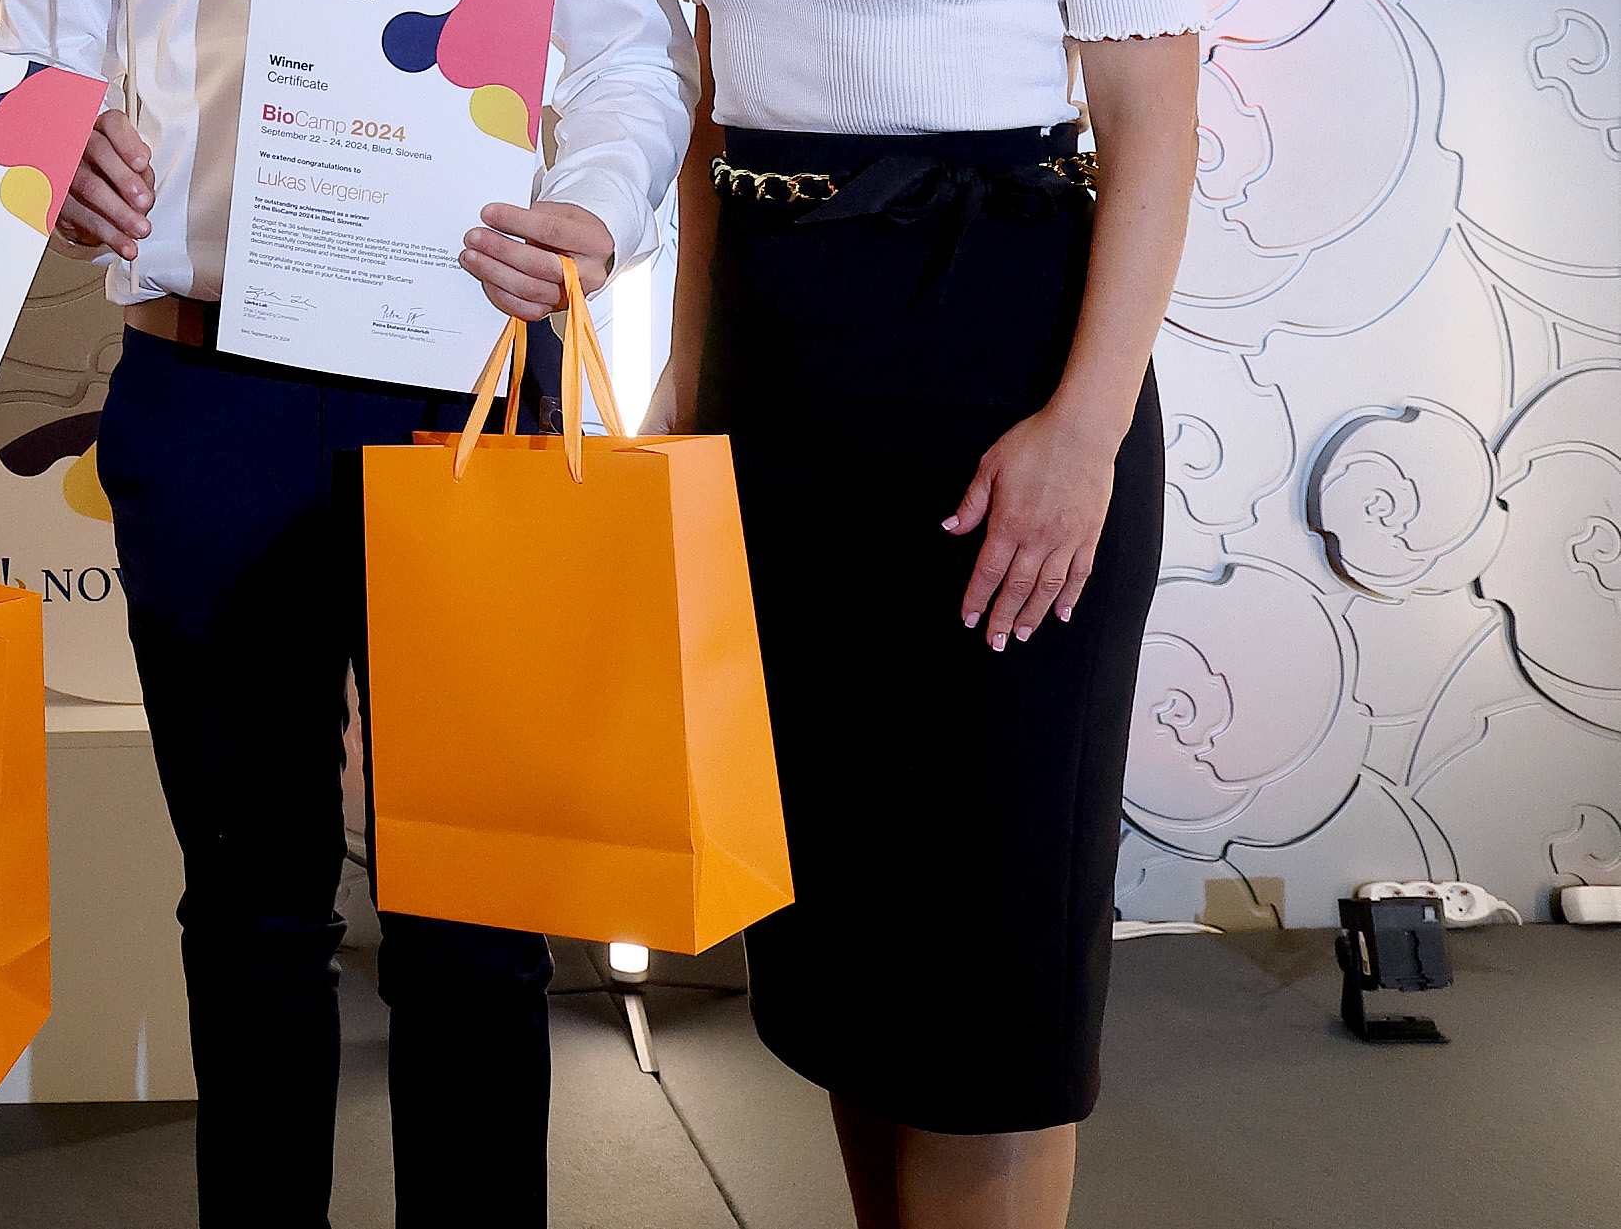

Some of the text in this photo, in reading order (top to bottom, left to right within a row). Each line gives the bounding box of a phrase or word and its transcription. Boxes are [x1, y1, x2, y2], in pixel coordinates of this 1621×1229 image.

[268, 54, 314, 71] Winner
[267, 71, 327, 90] Certificate
[262, 104, 405, 142] BioCamp 2024
[261, 126, 306, 140] September
[309, 133, 320, 142] 22
[329, 137, 342, 146] 24,
[345, 139, 369, 151] 2024,
[371, 143, 393, 155] Bled,
[395, 147, 431, 160] Slovenia
[272, 154, 295, 162] extend
[297, 158, 351, 171] congratulations
[256, 166, 388, 204] Lukas Vergeiner
[264, 199, 297, 209] outstanding
[299, 205, 335, 214] achievement
[271, 207, 297, 217] BioCamp
[321, 215, 335, 223] Bled,
[337, 218, 363, 227] Slovenia.
[428, 253, 458, 264] knowledg
